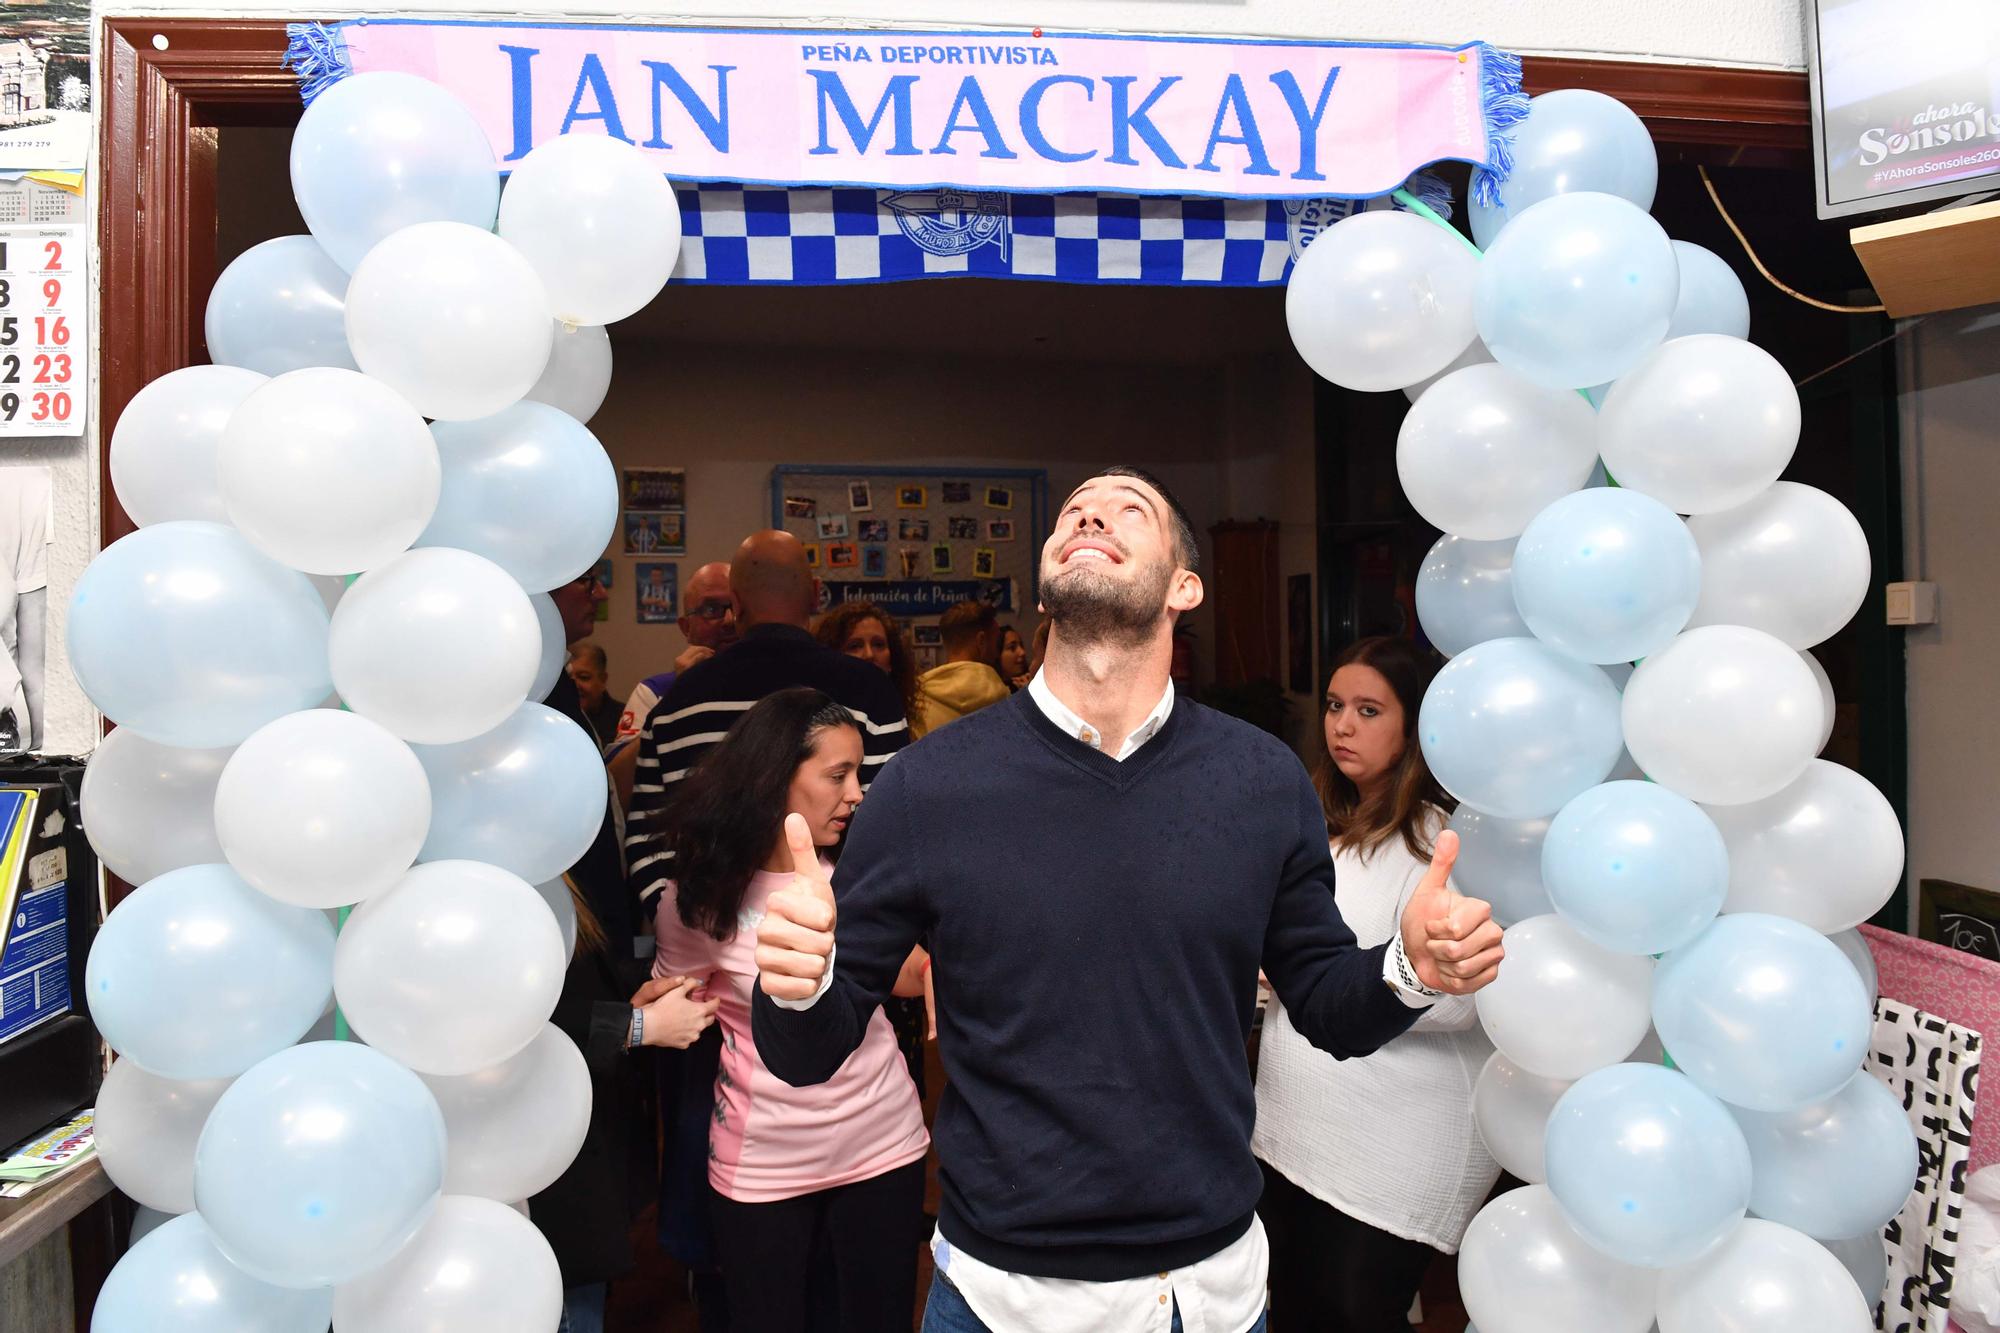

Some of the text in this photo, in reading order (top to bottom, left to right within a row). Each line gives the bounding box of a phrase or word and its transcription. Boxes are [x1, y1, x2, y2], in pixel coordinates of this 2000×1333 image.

[802, 43, 1058, 65] PEÑA DEPORTIVISTA
[806, 66, 1341, 181] MACKAY
[1913, 102, 1976, 126] ahora
[40, 230, 67, 238] Domingo
[44, 241, 62, 270] 2
[43, 279, 61, 307] 9
[35, 317, 70, 345] 16
[33, 354, 71, 383] 23
[32, 392, 71, 421] 30
[843, 584, 970, 606] Federación de Peñas
